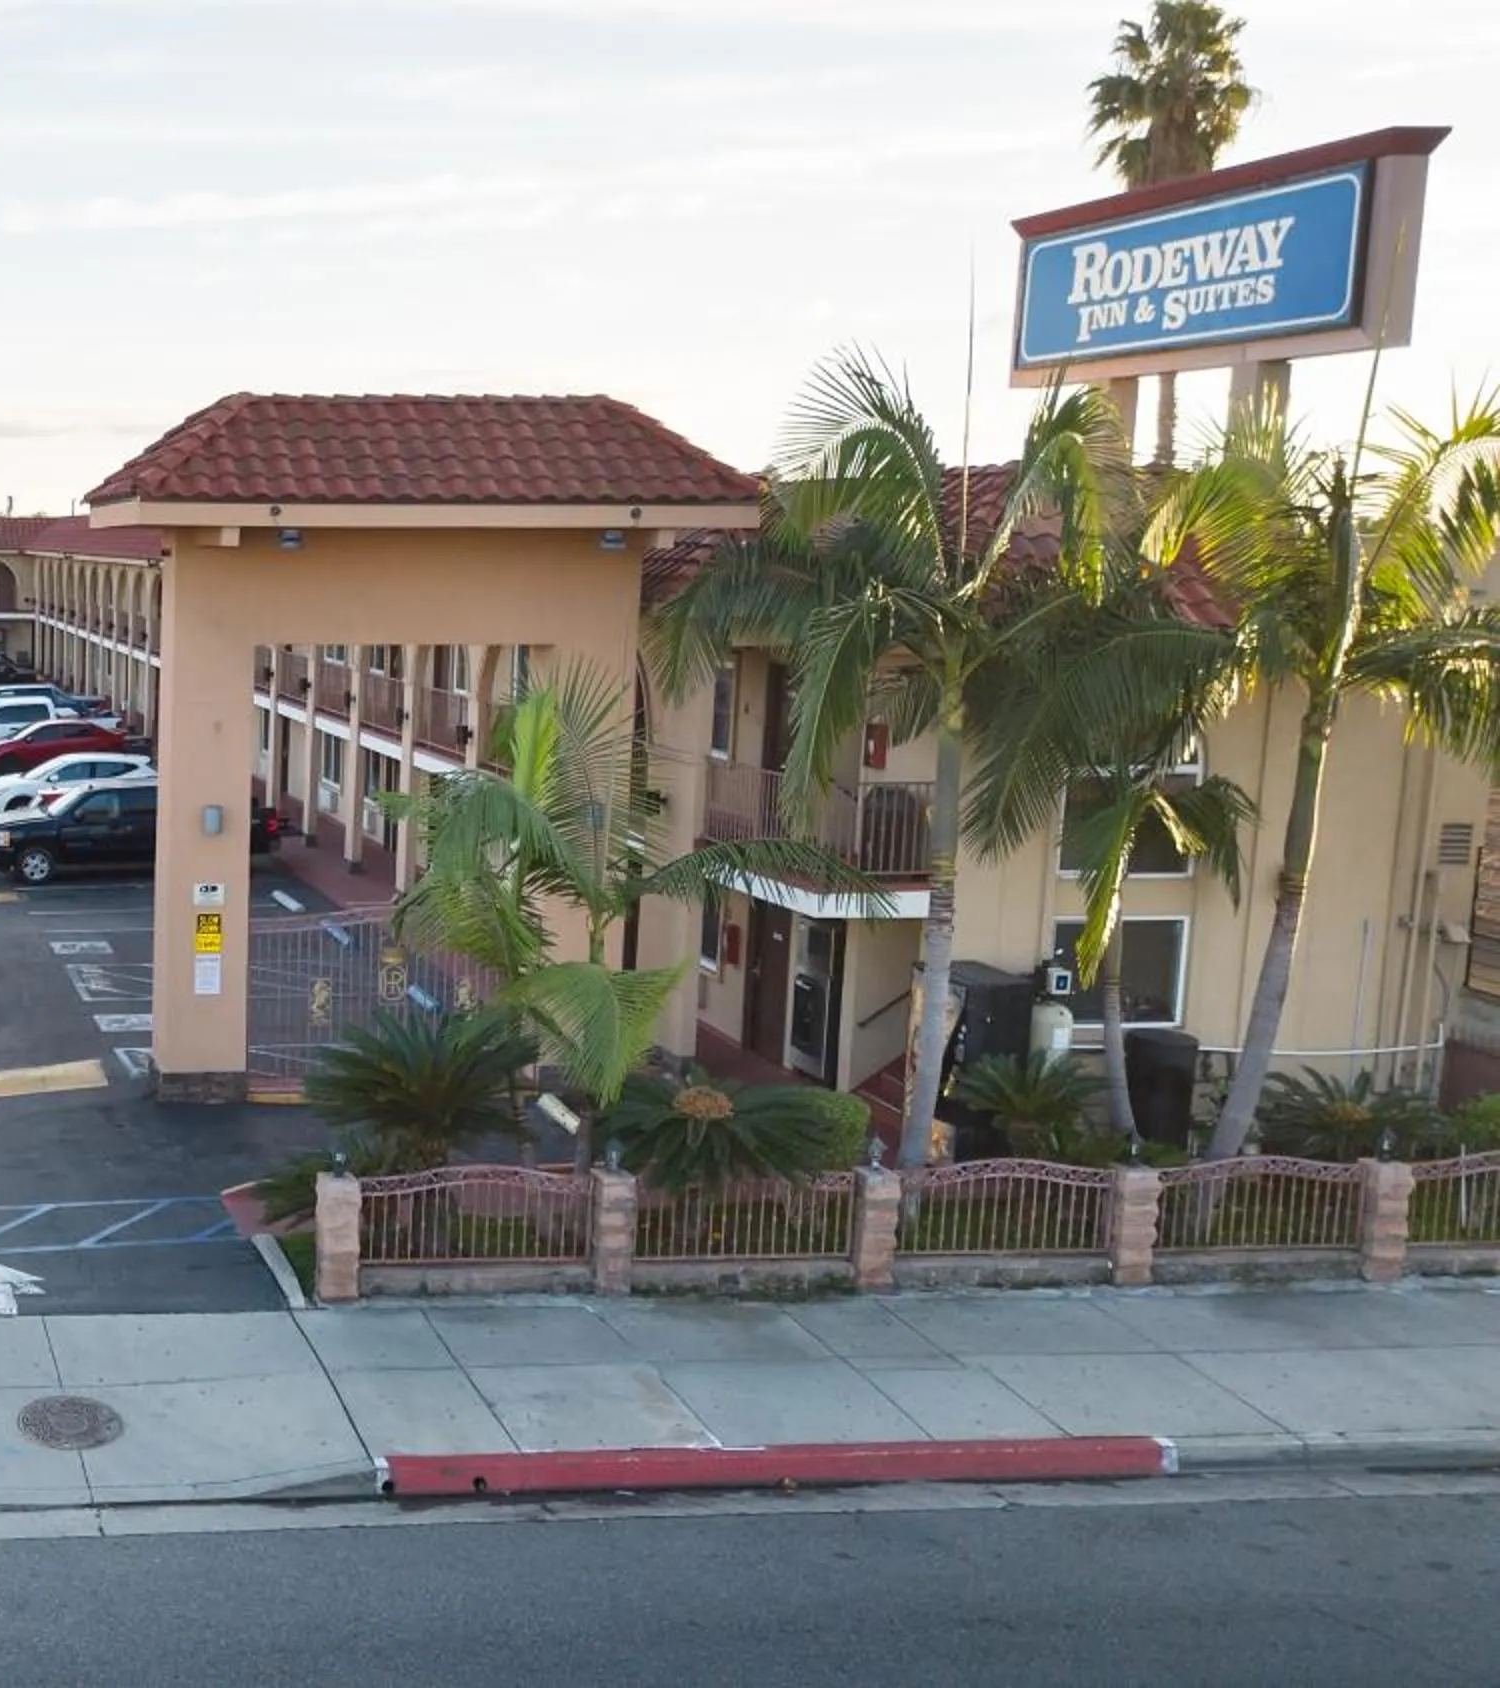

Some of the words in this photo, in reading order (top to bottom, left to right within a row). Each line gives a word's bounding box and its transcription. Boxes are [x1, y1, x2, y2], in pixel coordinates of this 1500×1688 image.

[1067, 216, 1296, 305] RODEWAY
[1076, 300, 1130, 342] INN
[1134, 296, 1156, 326] &
[1162, 273, 1276, 332] SUITES
